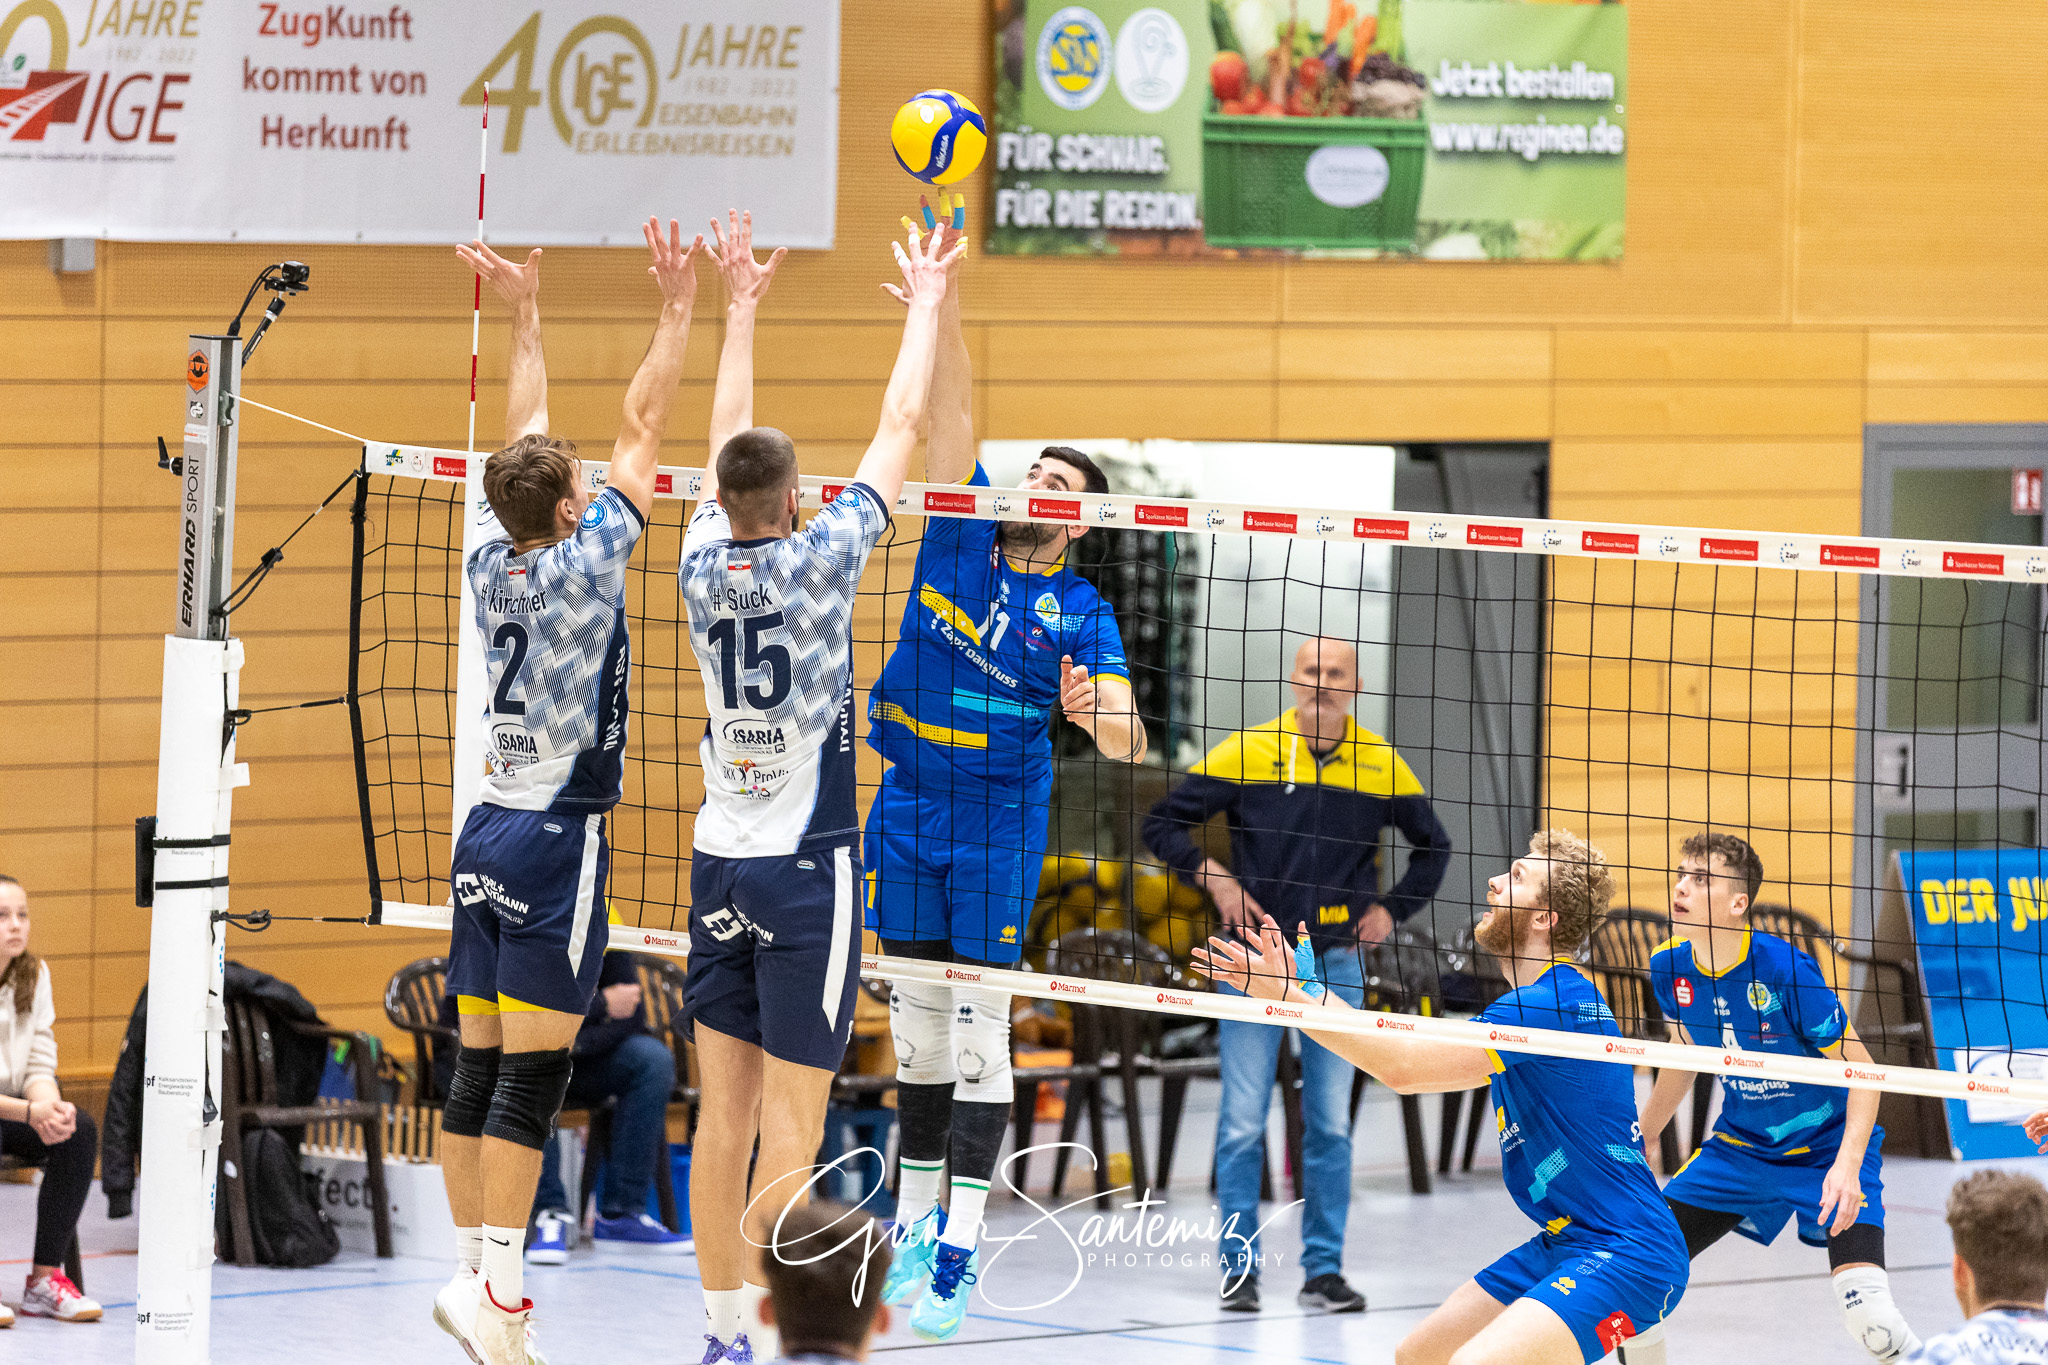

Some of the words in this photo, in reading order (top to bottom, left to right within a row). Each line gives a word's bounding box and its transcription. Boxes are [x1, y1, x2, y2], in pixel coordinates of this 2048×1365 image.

[79, 0, 201, 47] JAHRE
[258, 3, 413, 47] ZugKunft
[668, 23, 805, 81] JAHRE
[243, 57, 361, 95] kommt
[371, 70, 427, 97] von
[1432, 59, 1503, 98] Jetzt
[1505, 60, 1615, 101] bestellen
[83, 71, 192, 143] IGE
[658, 102, 798, 128] EISENBAHN
[261, 113, 409, 151] Herkunft
[575, 130, 796, 157] ERLEBNISREISEN
[186, 455, 200, 513] SPORT
[181, 518, 197, 628] ERHARD
[492, 621, 529, 716] 2
[707, 610, 792, 711] 15
[964, 648, 1018, 688] Daigfuss
[497, 732, 538, 754] ISARIA
[733, 727, 785, 745] ISARIA
[1920, 878, 2000, 926] DER
[651, 937, 678, 947] Marmot
[861, 961, 878, 970] rmot
[953, 970, 981, 982] Marmot
[1058, 982, 1086, 994] Marmot
[1164, 994, 1194, 1006] Marmot
[1273, 1006, 1303, 1018] Marmot
[1384, 1019, 1415, 1032] Marmot
[1498, 1031, 1529, 1044] Marmot
[1614, 1043, 1646, 1056] Marmot
[1732, 1056, 1764, 1069] Marmot
[1853, 1068, 1886, 1082] Marmot
[1976, 1081, 2010, 1095] Marmot
[137, 1312, 151, 1325] apf
